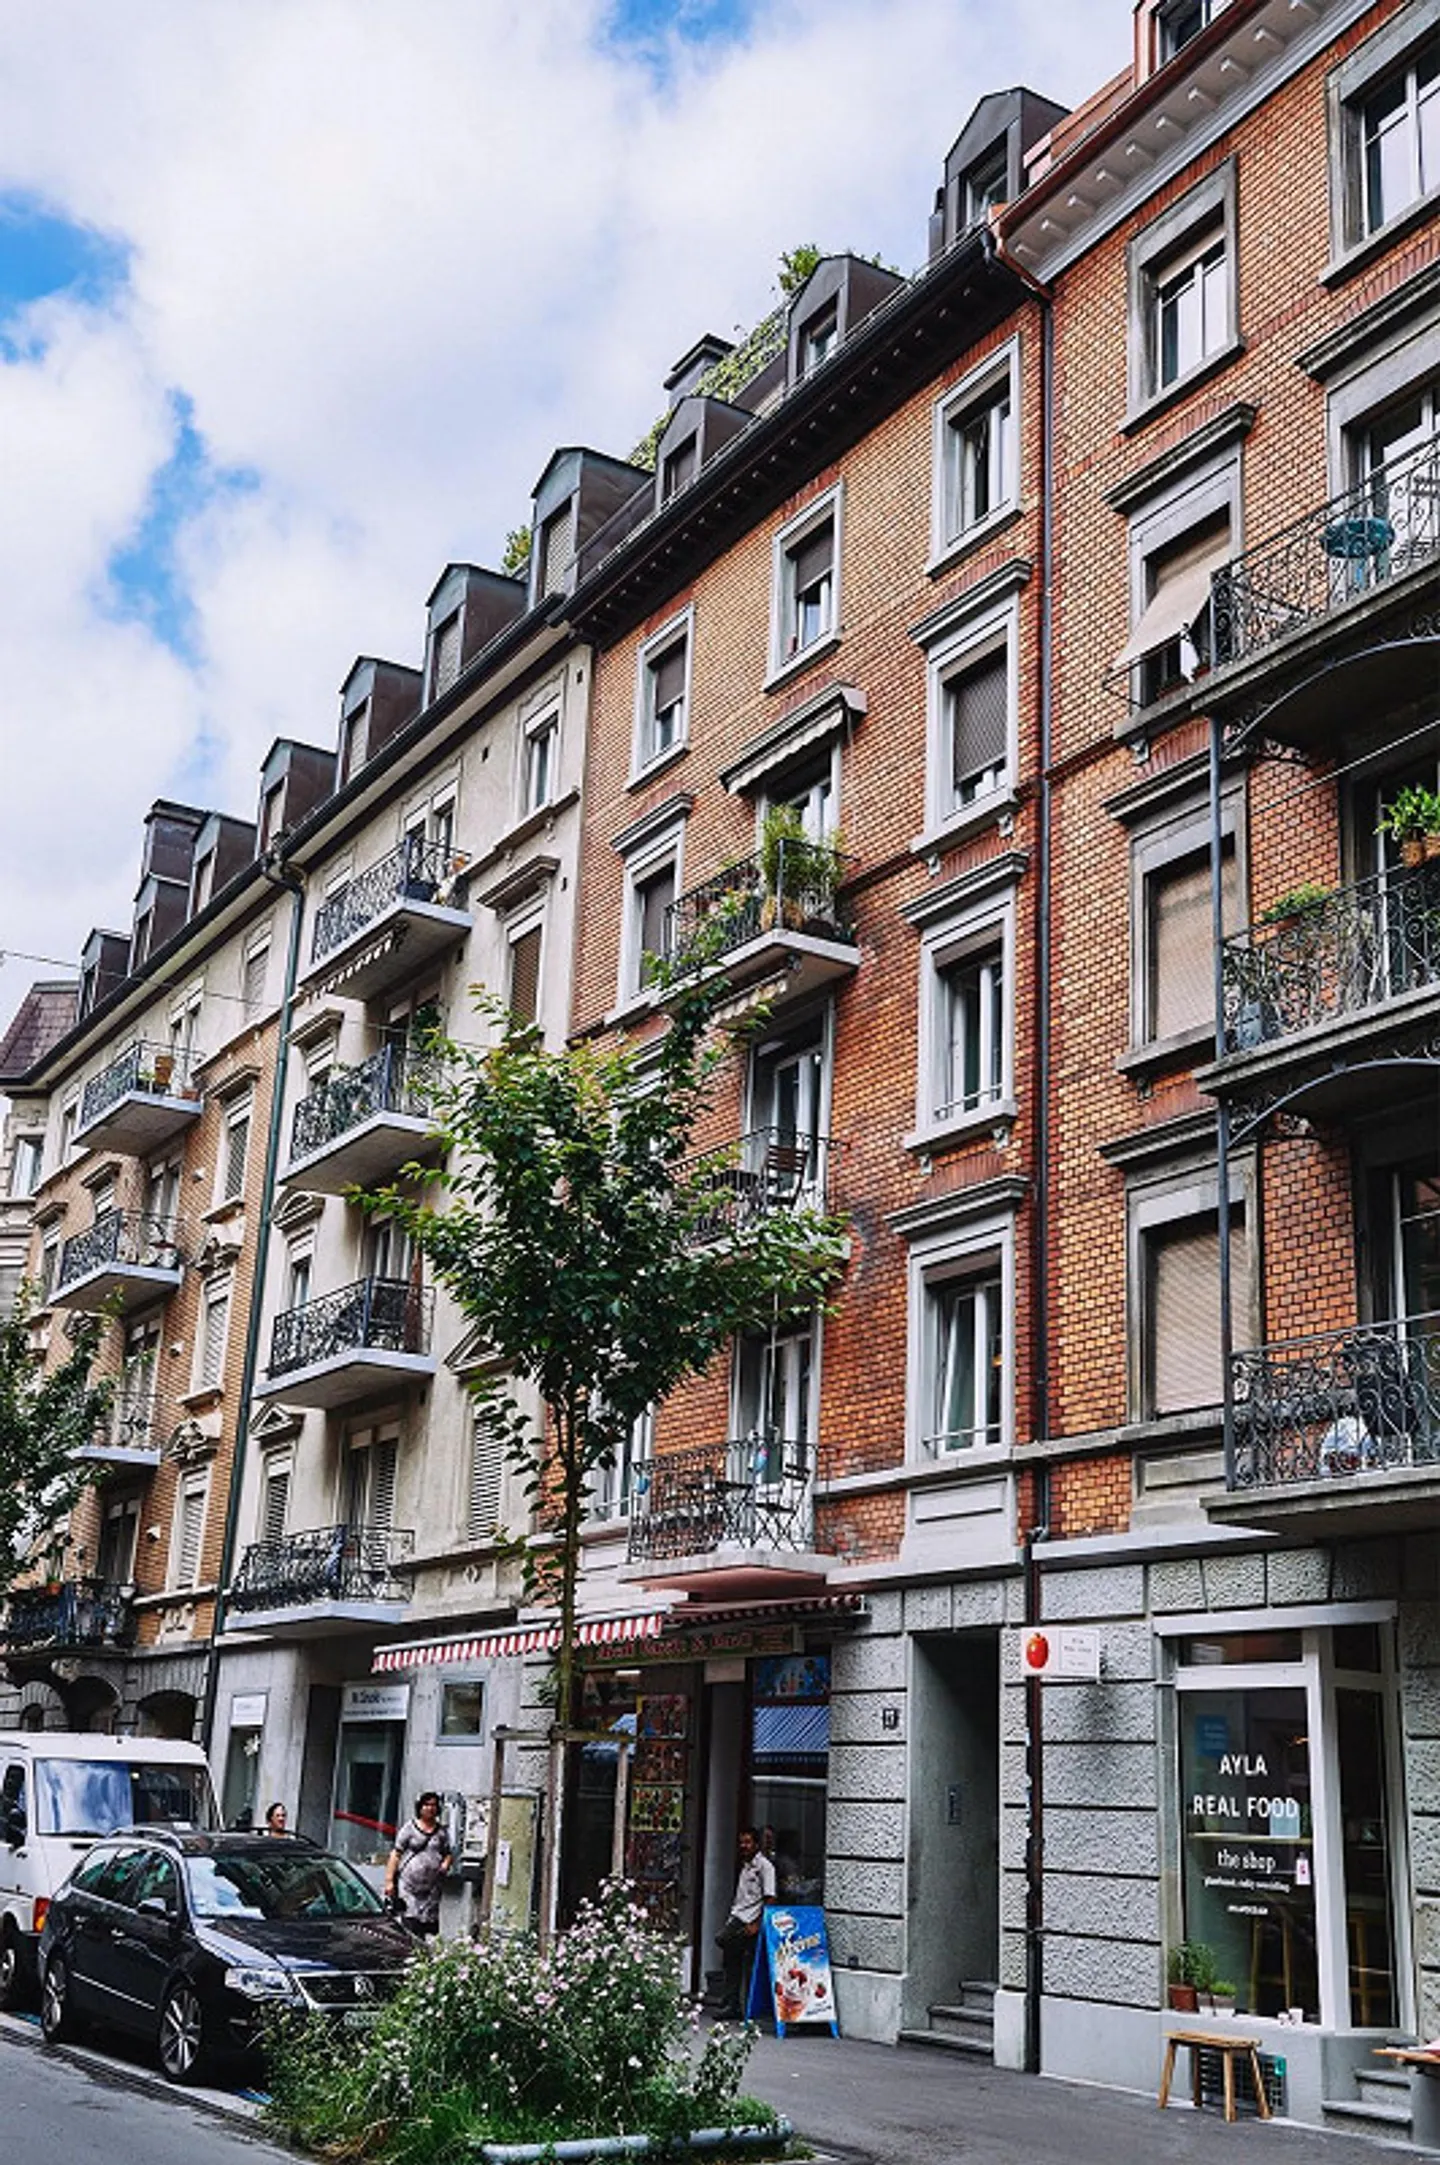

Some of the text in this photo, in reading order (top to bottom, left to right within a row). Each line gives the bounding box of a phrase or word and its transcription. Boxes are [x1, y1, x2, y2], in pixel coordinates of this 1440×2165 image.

[1219, 1754, 1268, 1776] AYLA
[1193, 1794, 1299, 1818] REAL FOOD
[1217, 1848, 1276, 1874] the shop
